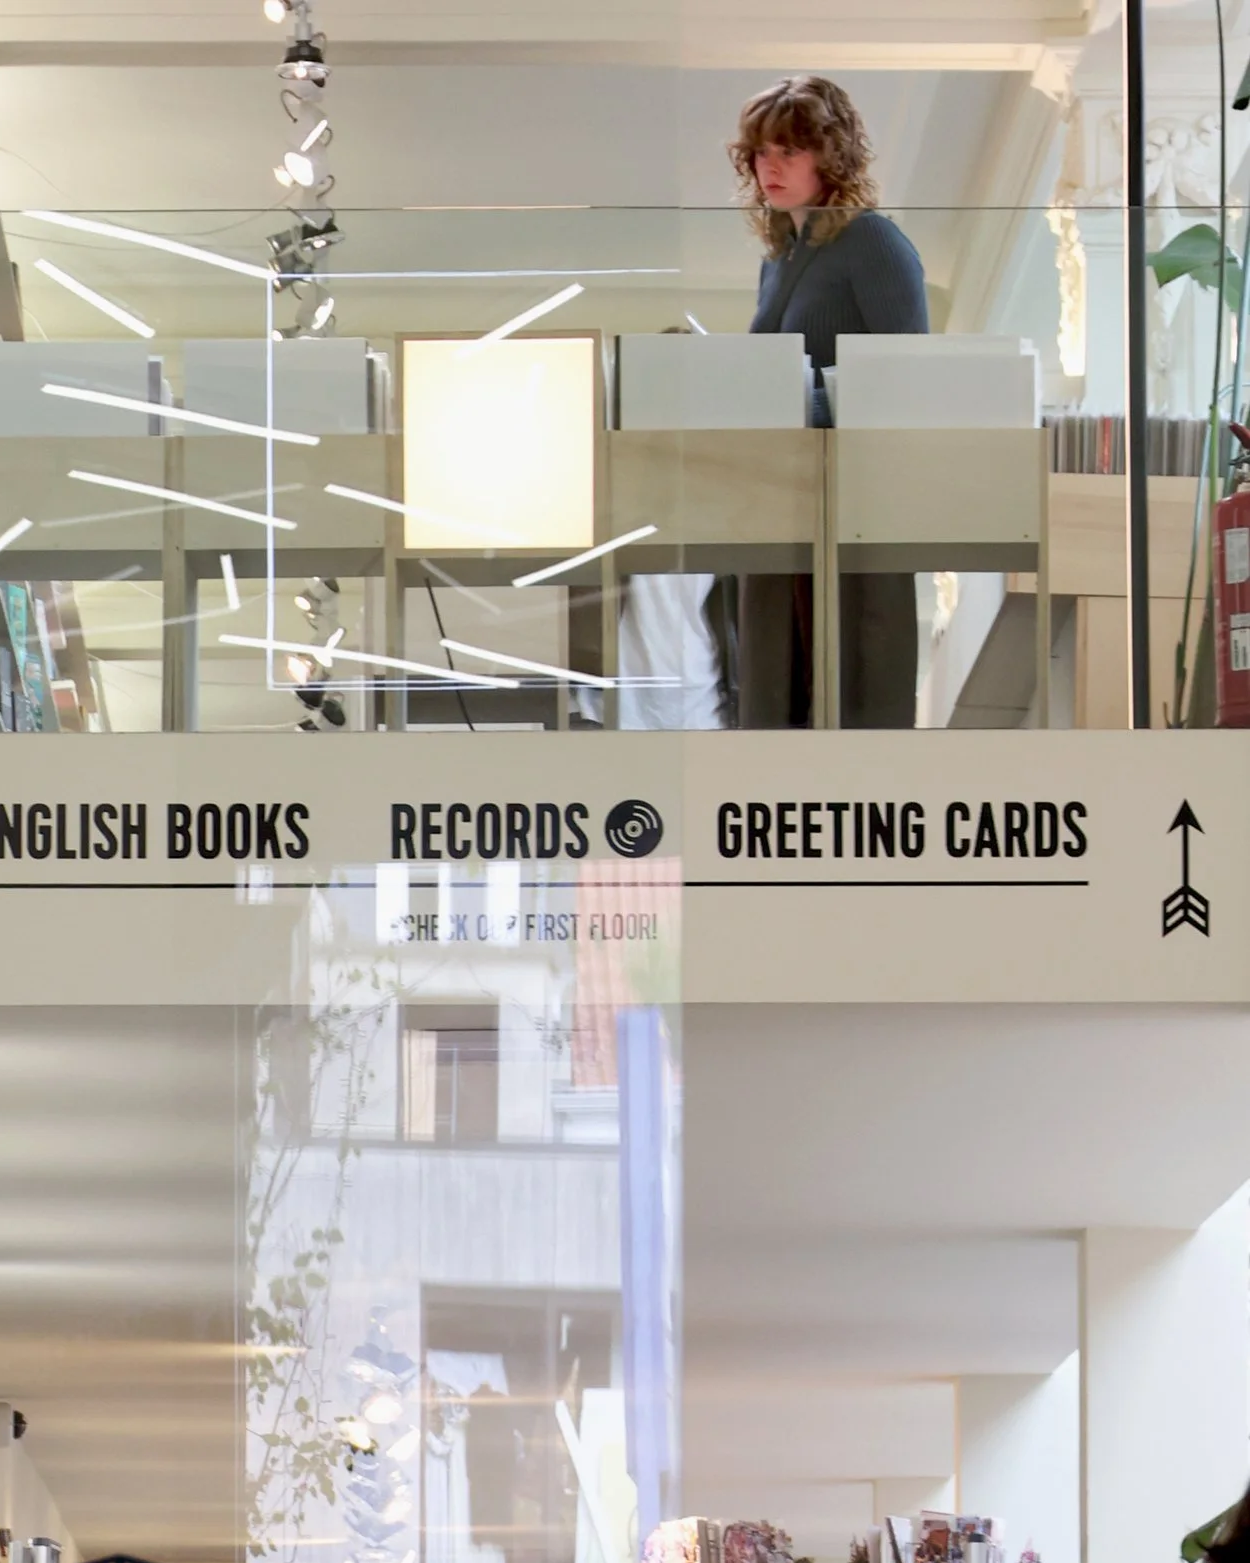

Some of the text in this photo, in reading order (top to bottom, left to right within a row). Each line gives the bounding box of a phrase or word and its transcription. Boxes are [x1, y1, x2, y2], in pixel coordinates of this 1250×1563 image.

[167, 803, 310, 859] BOOKS
[392, 803, 589, 859] RECORDS
[717, 801, 1087, 858] GREETING CARDS
[405, 914, 468, 941] CHECK
[526, 914, 580, 940] FIRST
[590, 913, 657, 940] FLOOR!
